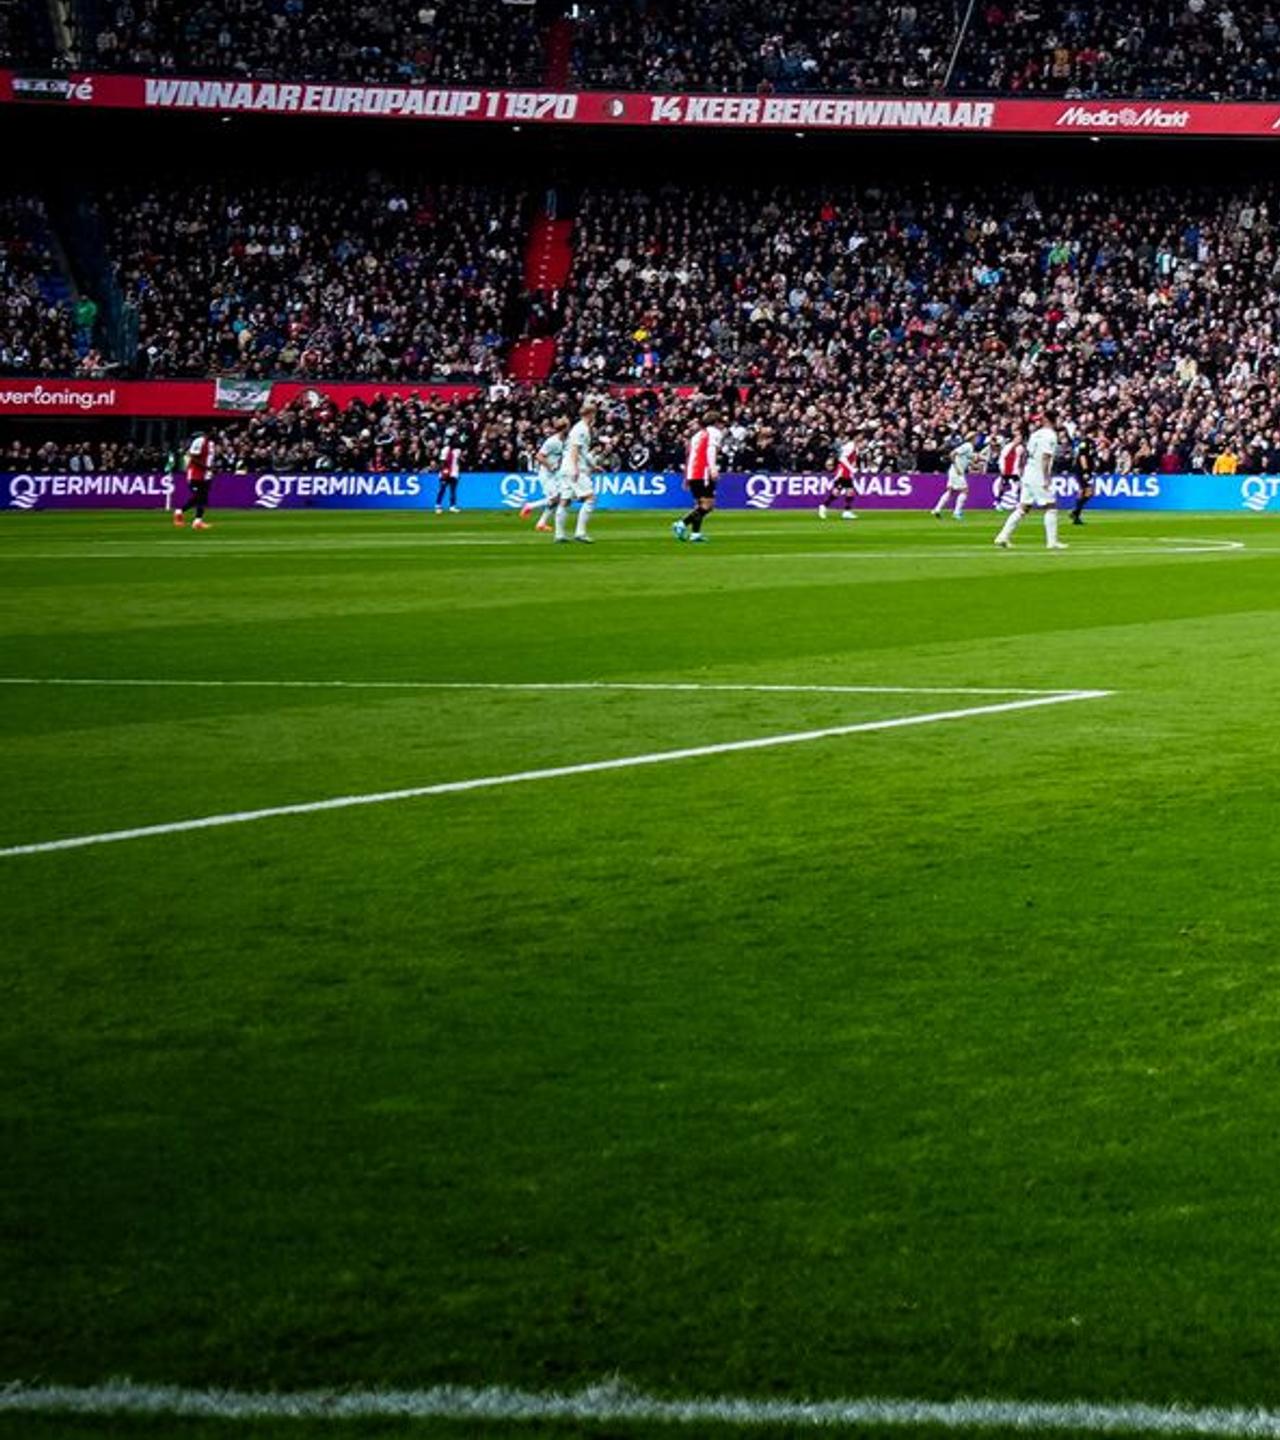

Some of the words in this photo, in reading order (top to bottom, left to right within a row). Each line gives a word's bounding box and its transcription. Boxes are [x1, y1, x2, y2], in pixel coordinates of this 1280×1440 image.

[145, 79, 301, 110] WINNAAR
[302, 85, 480, 117] EUROPACUP
[504, 93, 578, 119] 1970
[650, 96, 681, 121] 14
[684, 98, 760, 123] KEER
[762, 99, 995, 127] BEKERWINNAAR
[9, 474, 175, 508] QTERMINALS
[255, 474, 421, 508] QTERMINALS
[746, 474, 912, 508] QTERMNALS
